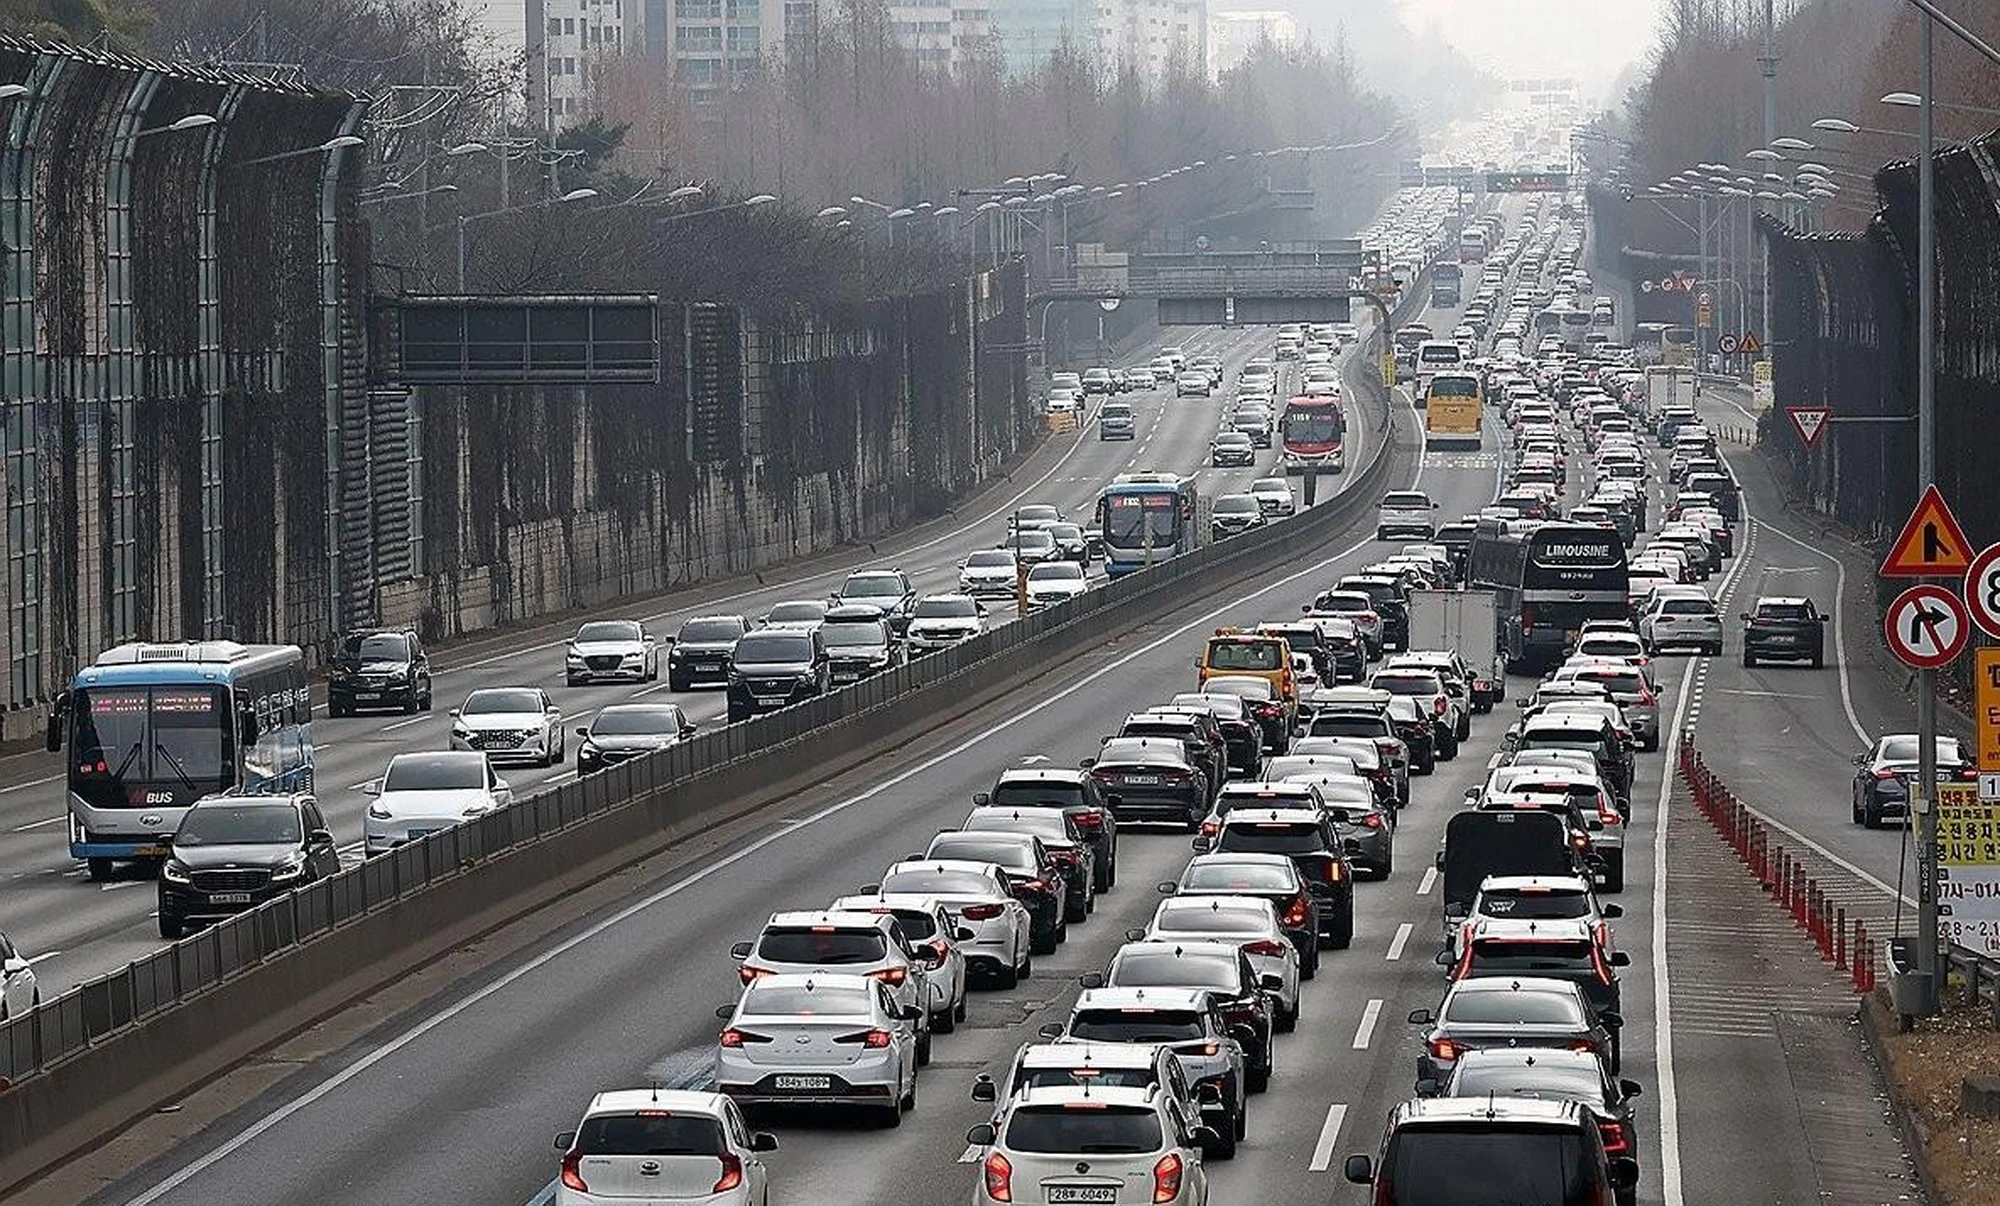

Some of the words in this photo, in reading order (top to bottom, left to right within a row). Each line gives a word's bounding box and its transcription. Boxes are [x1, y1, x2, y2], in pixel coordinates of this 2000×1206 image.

[1546, 545, 1609, 557] LIMOUSINE
[146, 791, 173, 804] BUS
[1936, 808, 1994, 820] 부고속도로
[1936, 822, 2000, 840] 스전용차
[1936, 843, 1976, 861] 영시간
